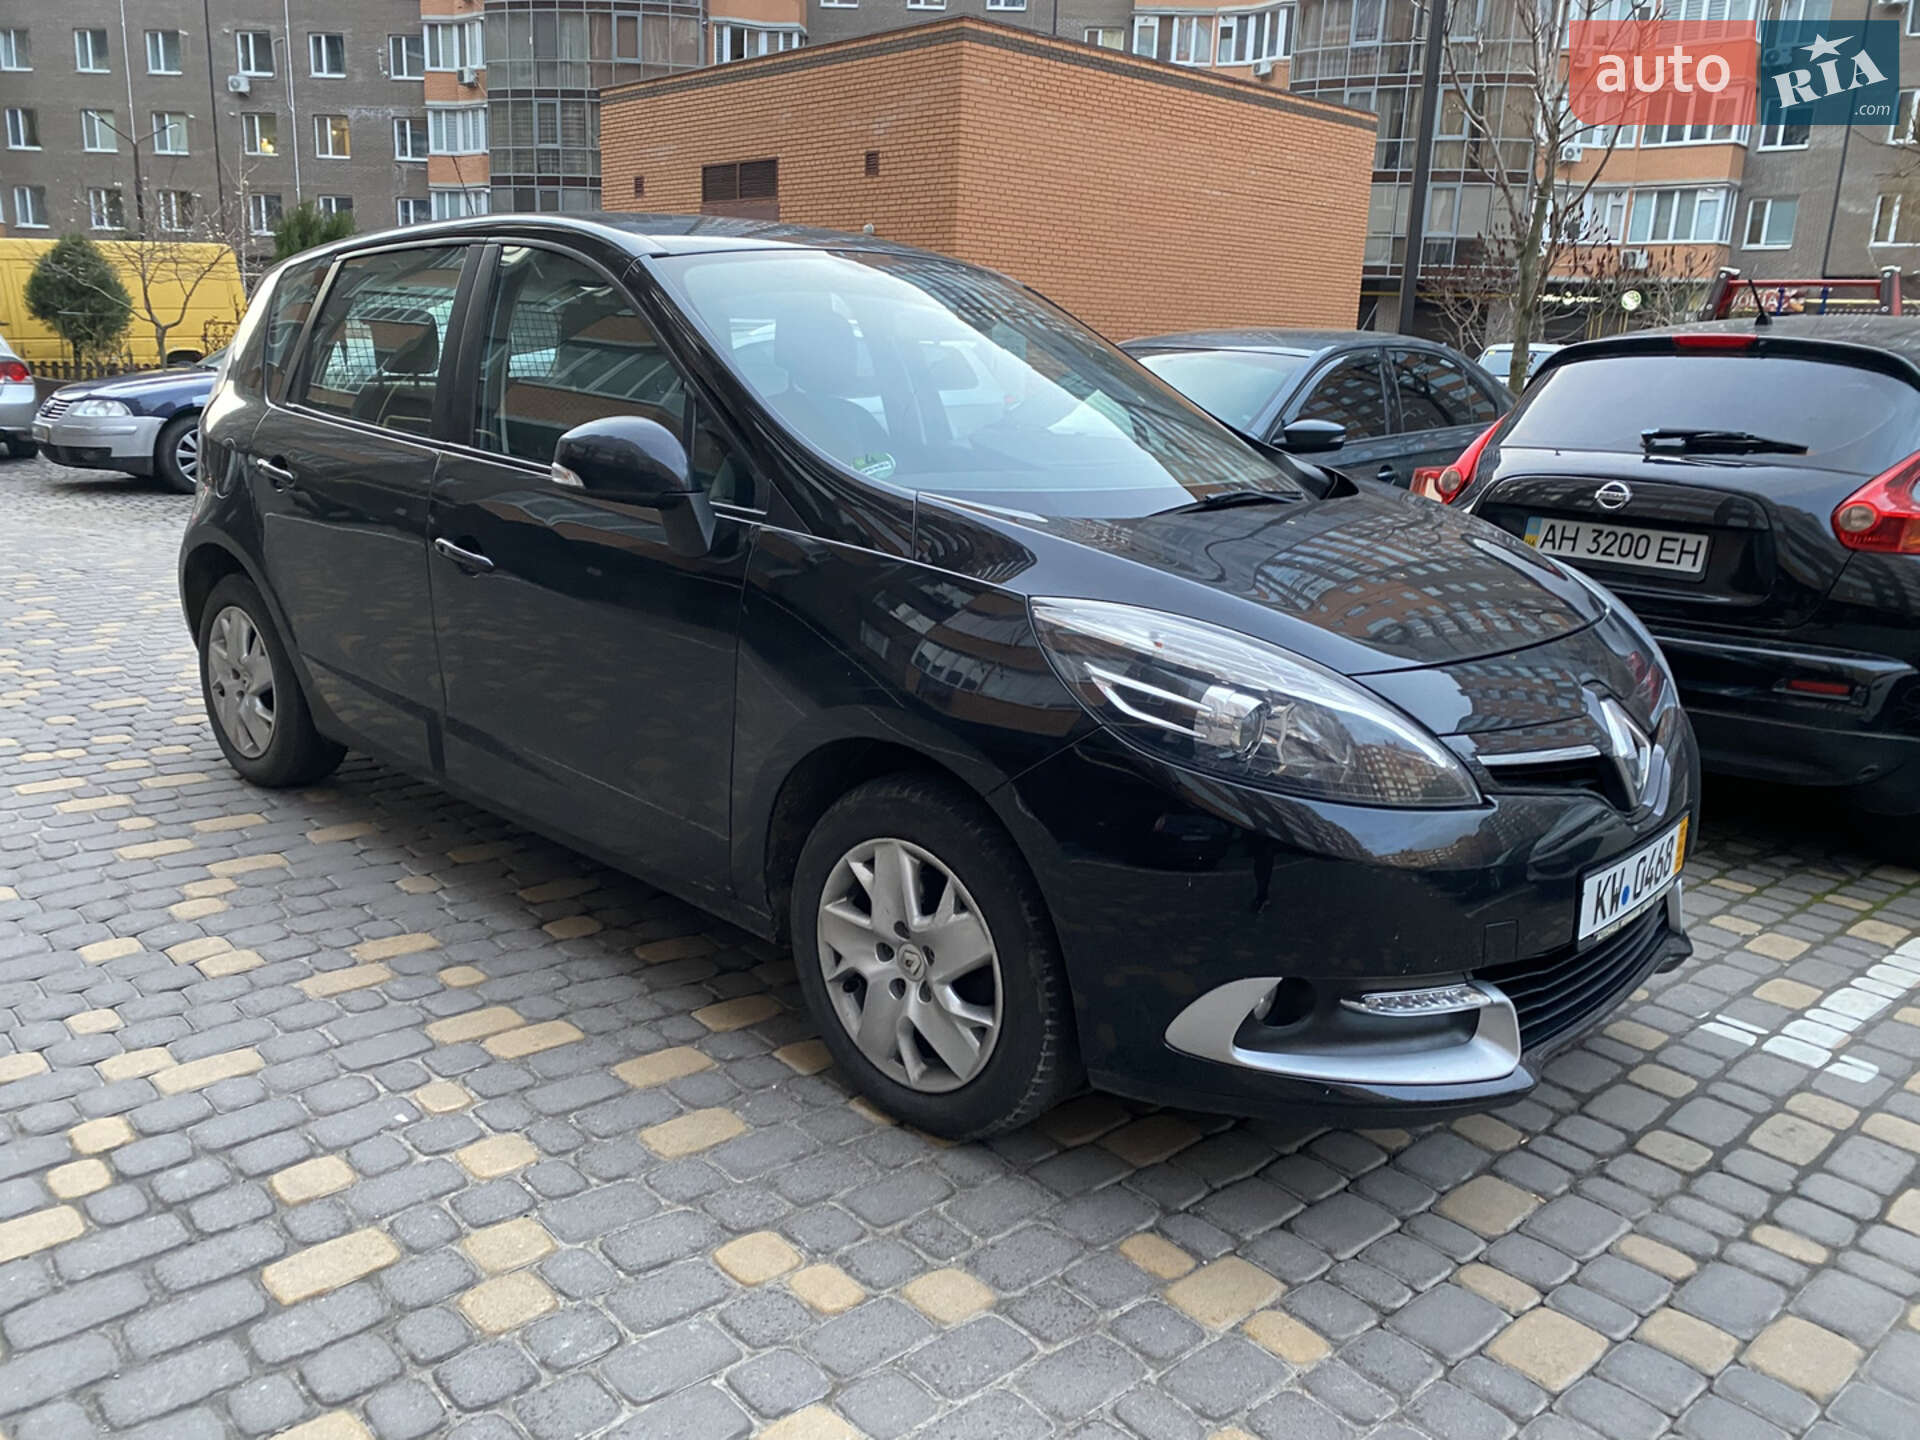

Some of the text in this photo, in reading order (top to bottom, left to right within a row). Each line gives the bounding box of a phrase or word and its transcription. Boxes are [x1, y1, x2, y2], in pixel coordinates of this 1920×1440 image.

[1540, 524, 1702, 567] AH 3200 EH
[1633, 835, 1674, 901] 0468
